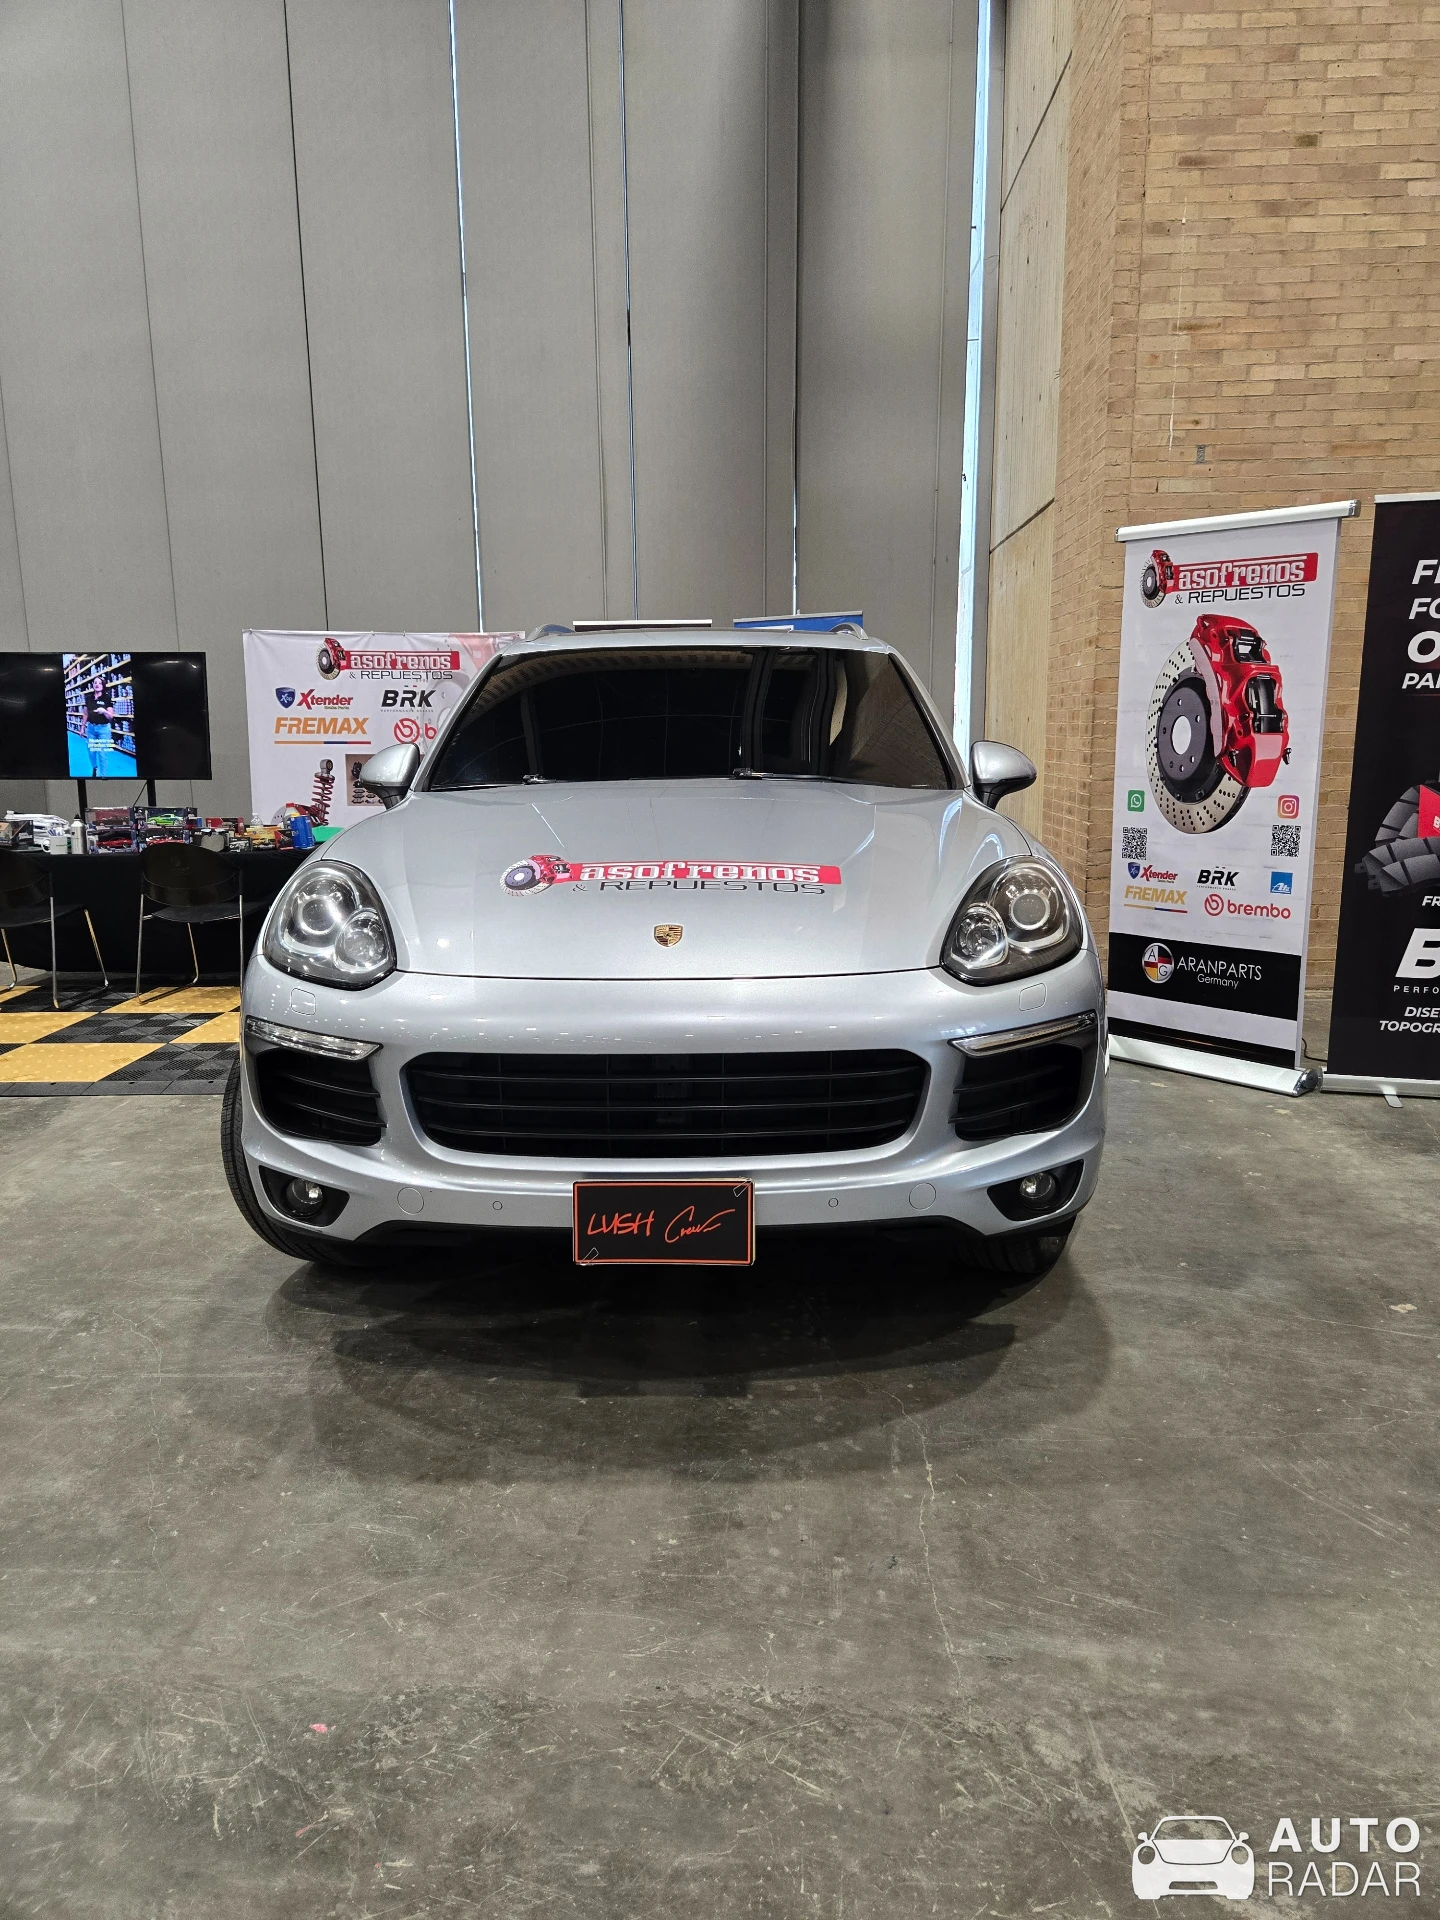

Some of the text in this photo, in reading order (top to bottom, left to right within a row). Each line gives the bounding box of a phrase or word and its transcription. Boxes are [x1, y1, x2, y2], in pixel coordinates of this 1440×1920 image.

[1178, 561, 1306, 590] asofrenos
[1174, 583, 1305, 604] & REPUESTOS
[350, 652, 451, 670] asofrenos
[349, 670, 453, 680] & REPUESTOS
[296, 688, 353, 710] Xtender
[381, 689, 436, 708] BRK
[274, 716, 369, 735] FREMAX
[579, 862, 820, 883] asofrenos
[1140, 864, 1178, 882] Xtender
[1197, 869, 1240, 887] BRK
[572, 880, 825, 895] & REPUESTOS
[1124, 884, 1188, 905] FREMAX
[1227, 900, 1291, 920] brembo
[1176, 956, 1262, 981] ARANPARTS
[1197, 973, 1240, 989] Germany
[586, 1210, 655, 1237] LUSH
